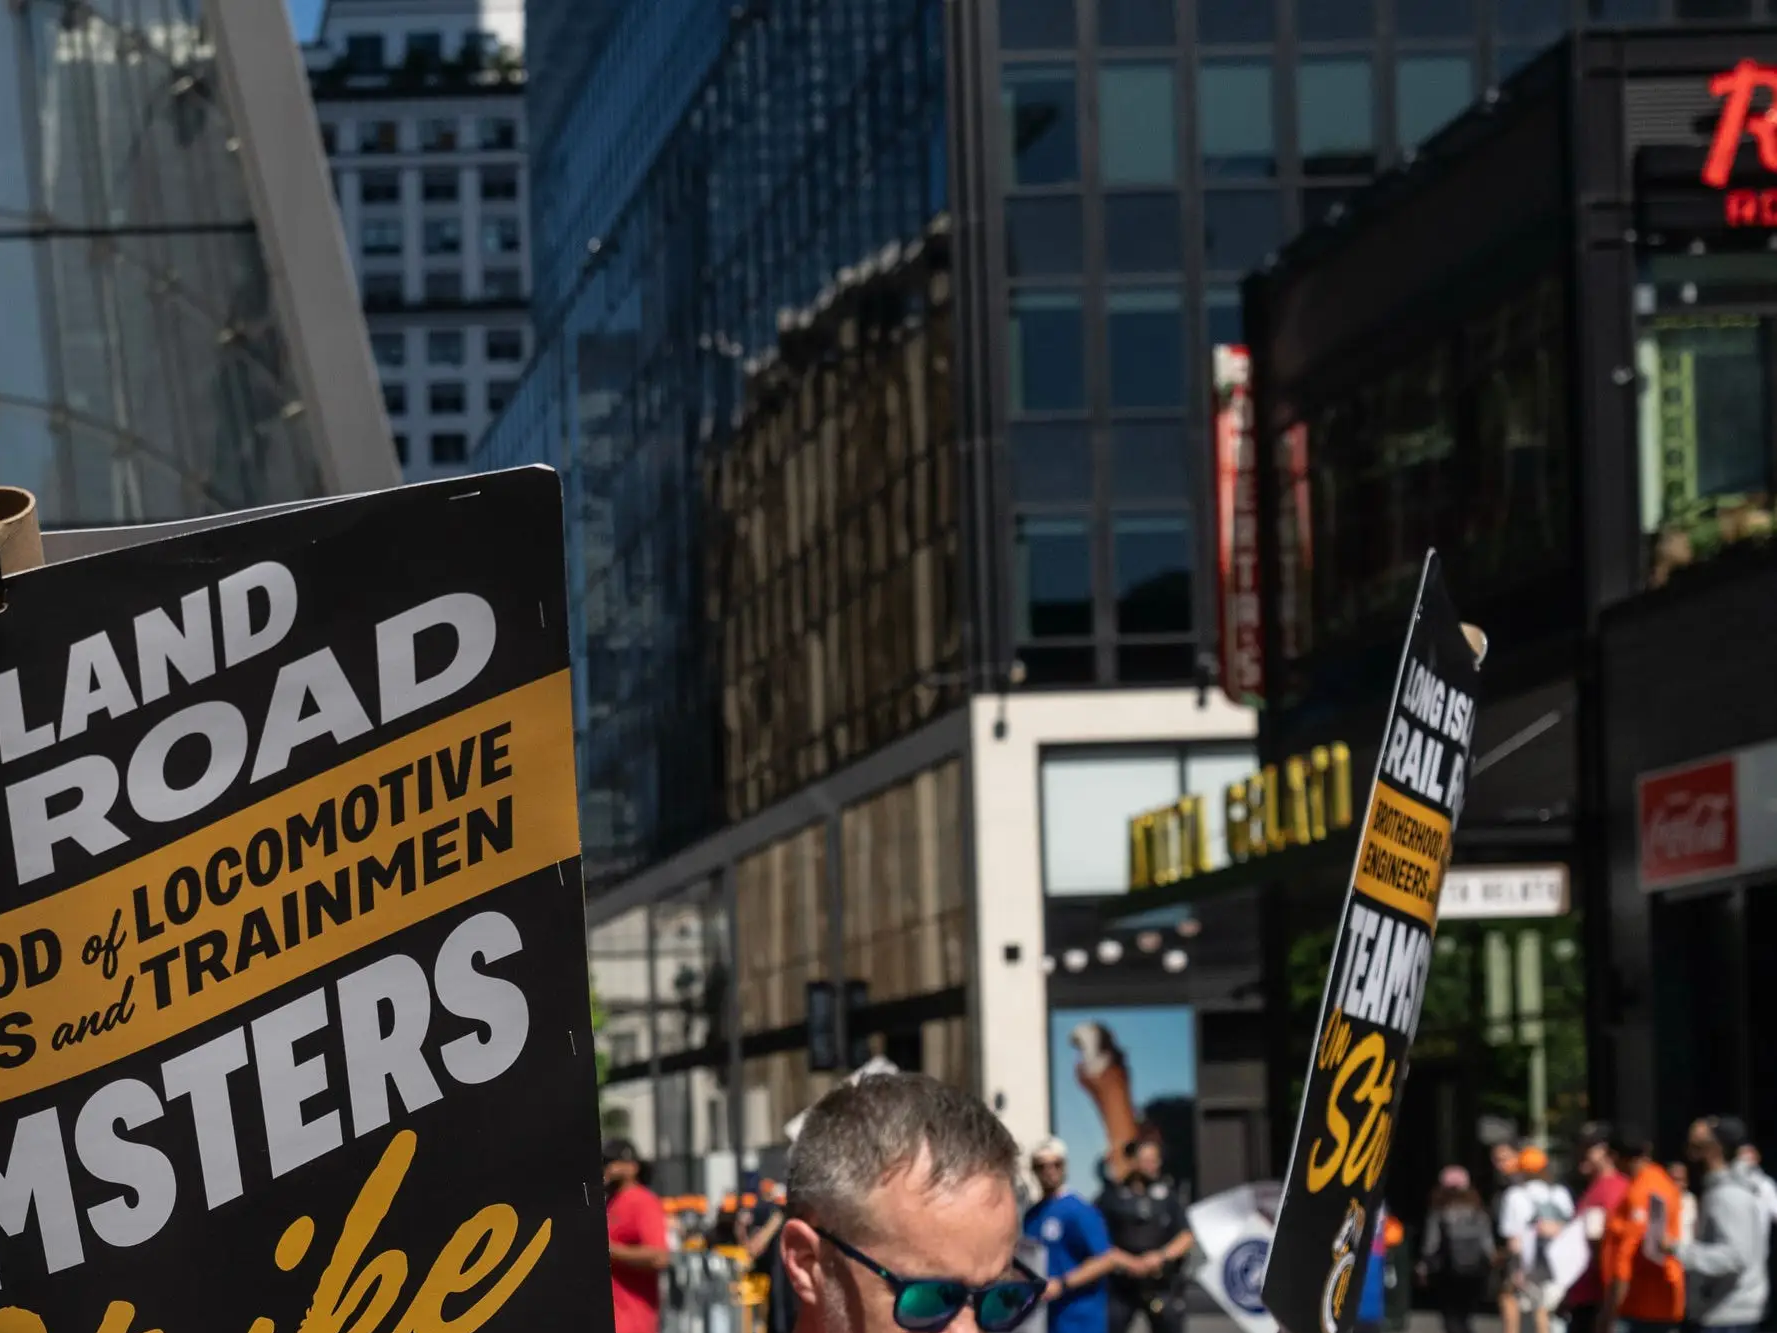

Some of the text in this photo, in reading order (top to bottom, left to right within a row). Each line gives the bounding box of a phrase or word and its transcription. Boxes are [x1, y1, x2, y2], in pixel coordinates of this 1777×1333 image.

[6, 591, 498, 886] ROAD
[1402, 657, 1475, 752] LONG ISL
[1385, 715, 1444, 804] RAIL
[81, 908, 127, 978] of
[131, 722, 514, 925] LOCOMOTIVE
[1363, 841, 1430, 899] ENGINEERS
[52, 976, 136, 1052] and
[140, 796, 516, 1007] TRAINMEN
[1319, 1006, 1352, 1070] On
